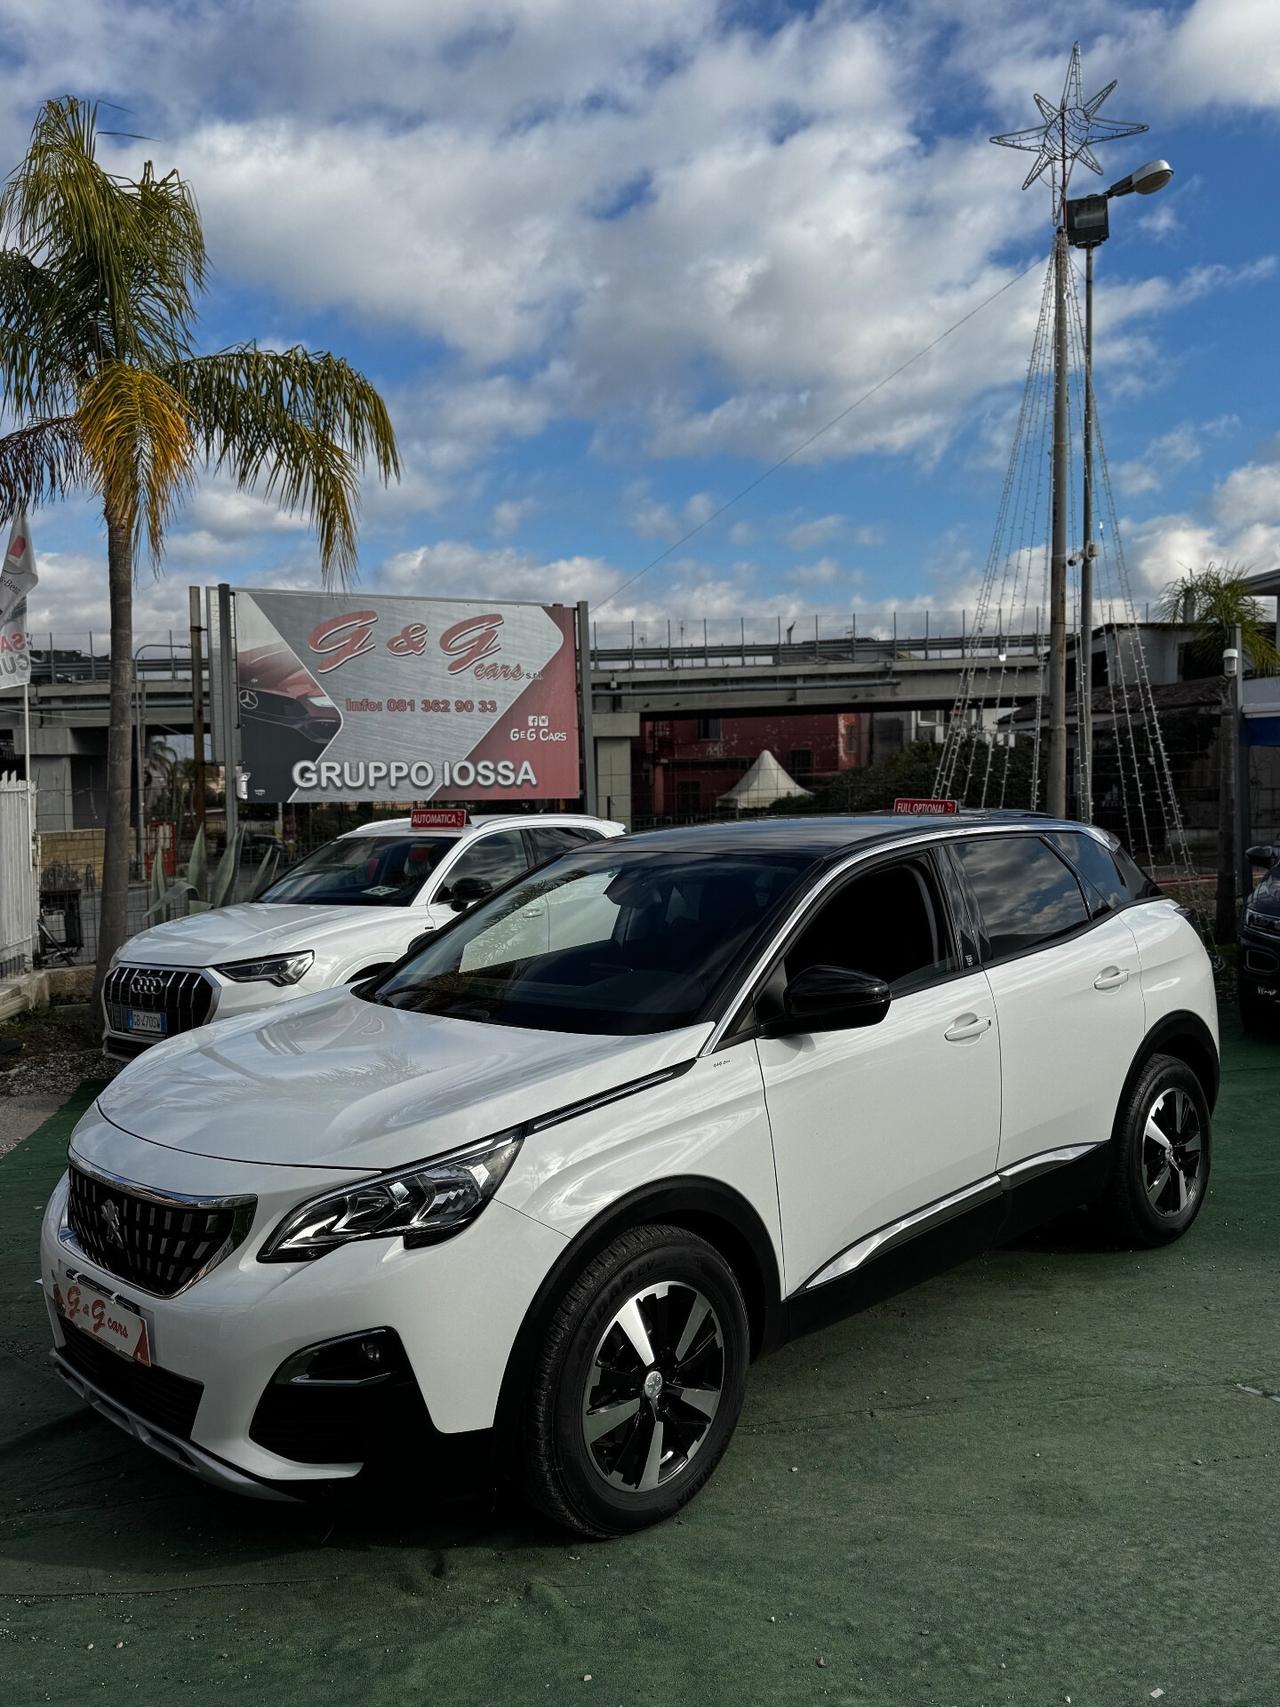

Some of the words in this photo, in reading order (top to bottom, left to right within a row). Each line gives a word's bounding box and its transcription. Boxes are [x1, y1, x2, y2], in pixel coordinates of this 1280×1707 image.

[386, 623, 428, 656] &
[346, 699, 383, 712] Info:
[387, 699, 416, 712] 081
[421, 700, 450, 712] 362
[454, 700, 474, 712] 90
[478, 701, 498, 713] 33
[292, 760, 434, 788] GRUPPO
[443, 761, 537, 787] IOSSA
[412, 814, 456, 824] AUTOMATICA
